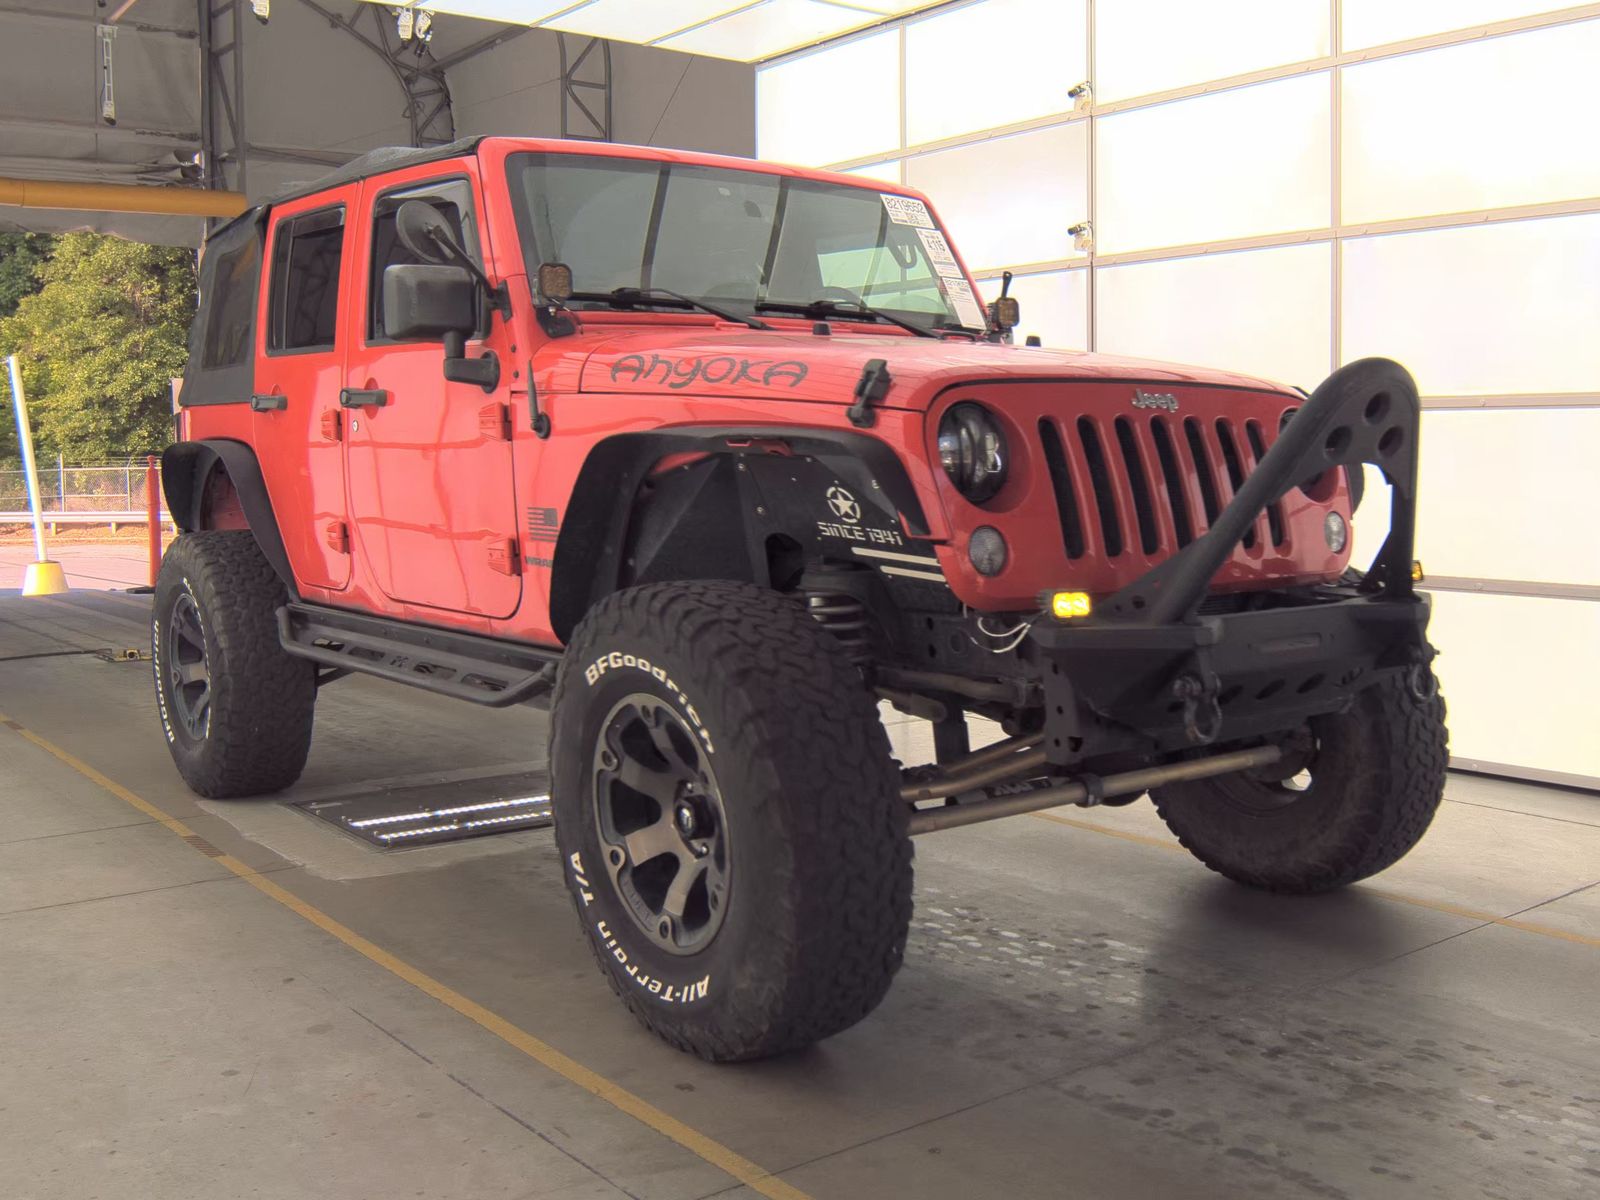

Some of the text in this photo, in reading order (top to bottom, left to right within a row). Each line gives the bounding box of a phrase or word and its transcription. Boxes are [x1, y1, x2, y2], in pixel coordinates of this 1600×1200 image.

[1131, 387, 1179, 414] Jeep
[865, 527, 904, 546] 1941
[584, 651, 715, 754] BFGoodrich
[570, 851, 595, 907] T/A
